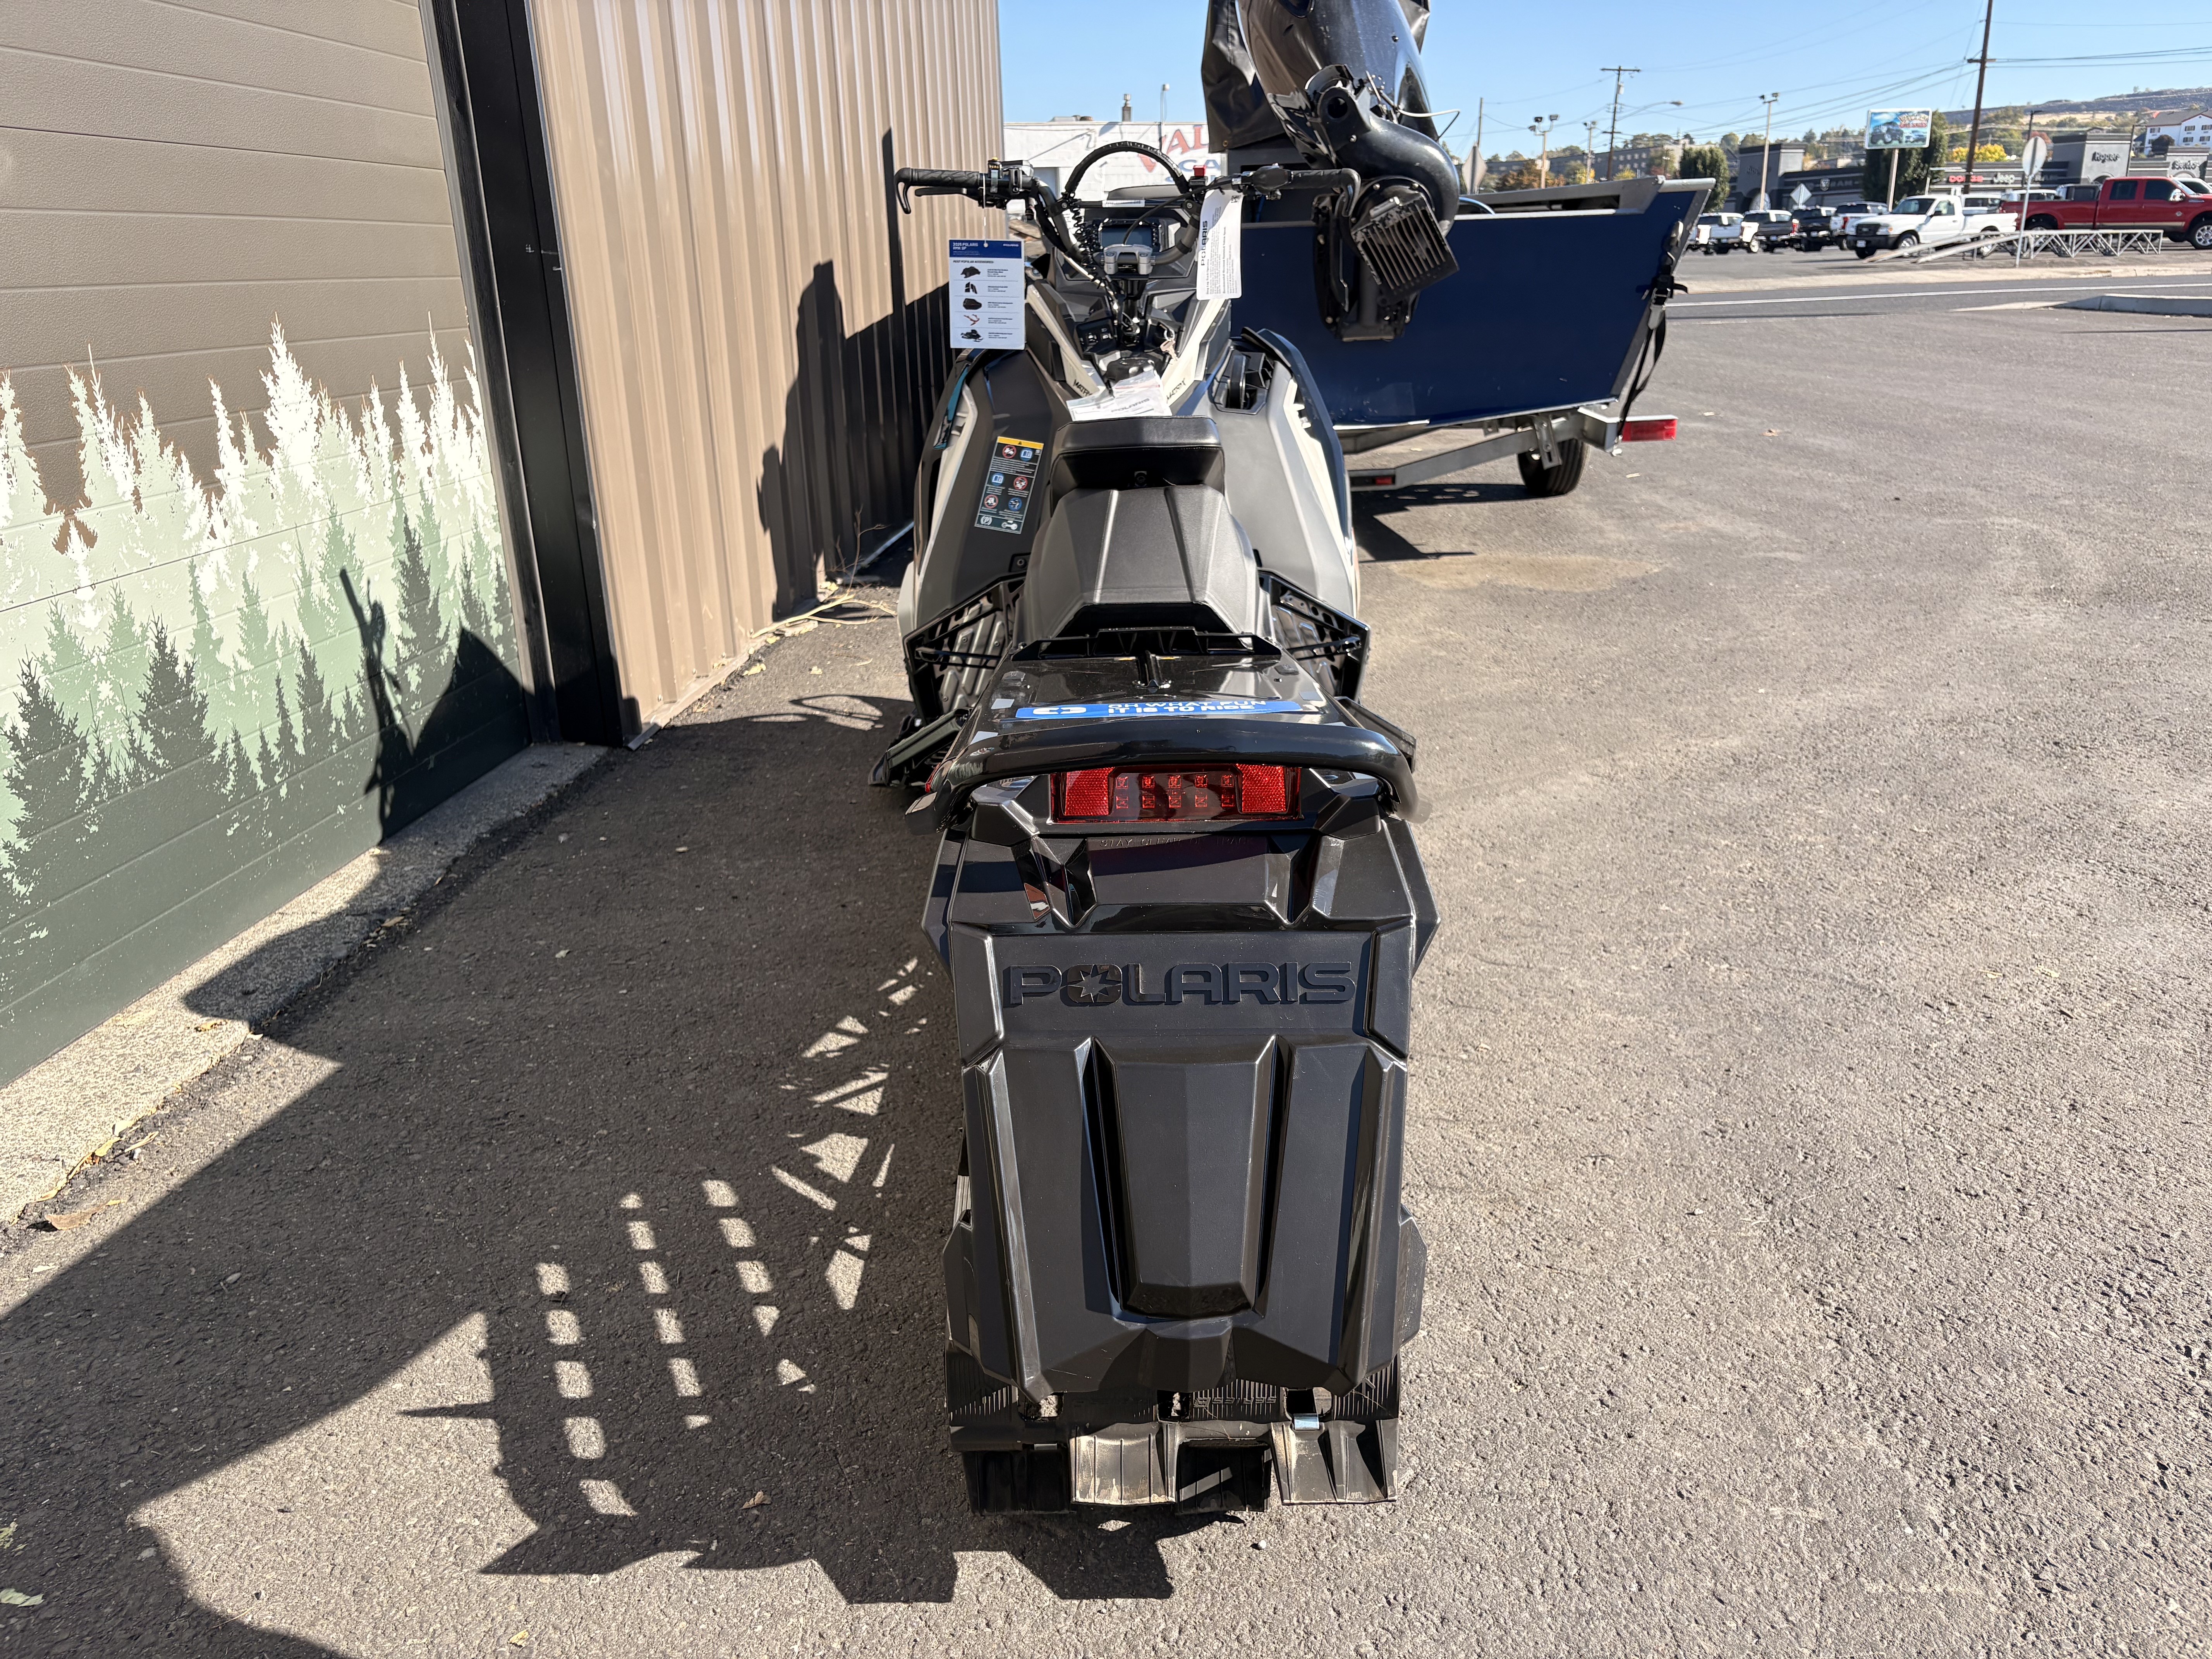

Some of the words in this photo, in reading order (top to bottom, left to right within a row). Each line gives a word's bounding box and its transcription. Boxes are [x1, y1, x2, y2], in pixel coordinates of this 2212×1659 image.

[1111, 398, 1150, 412] POLARIS
[1100, 839, 1132, 847] STAY
[1141, 838, 1181, 846] CLEAR
[1009, 962, 1356, 1005] POLARIS
